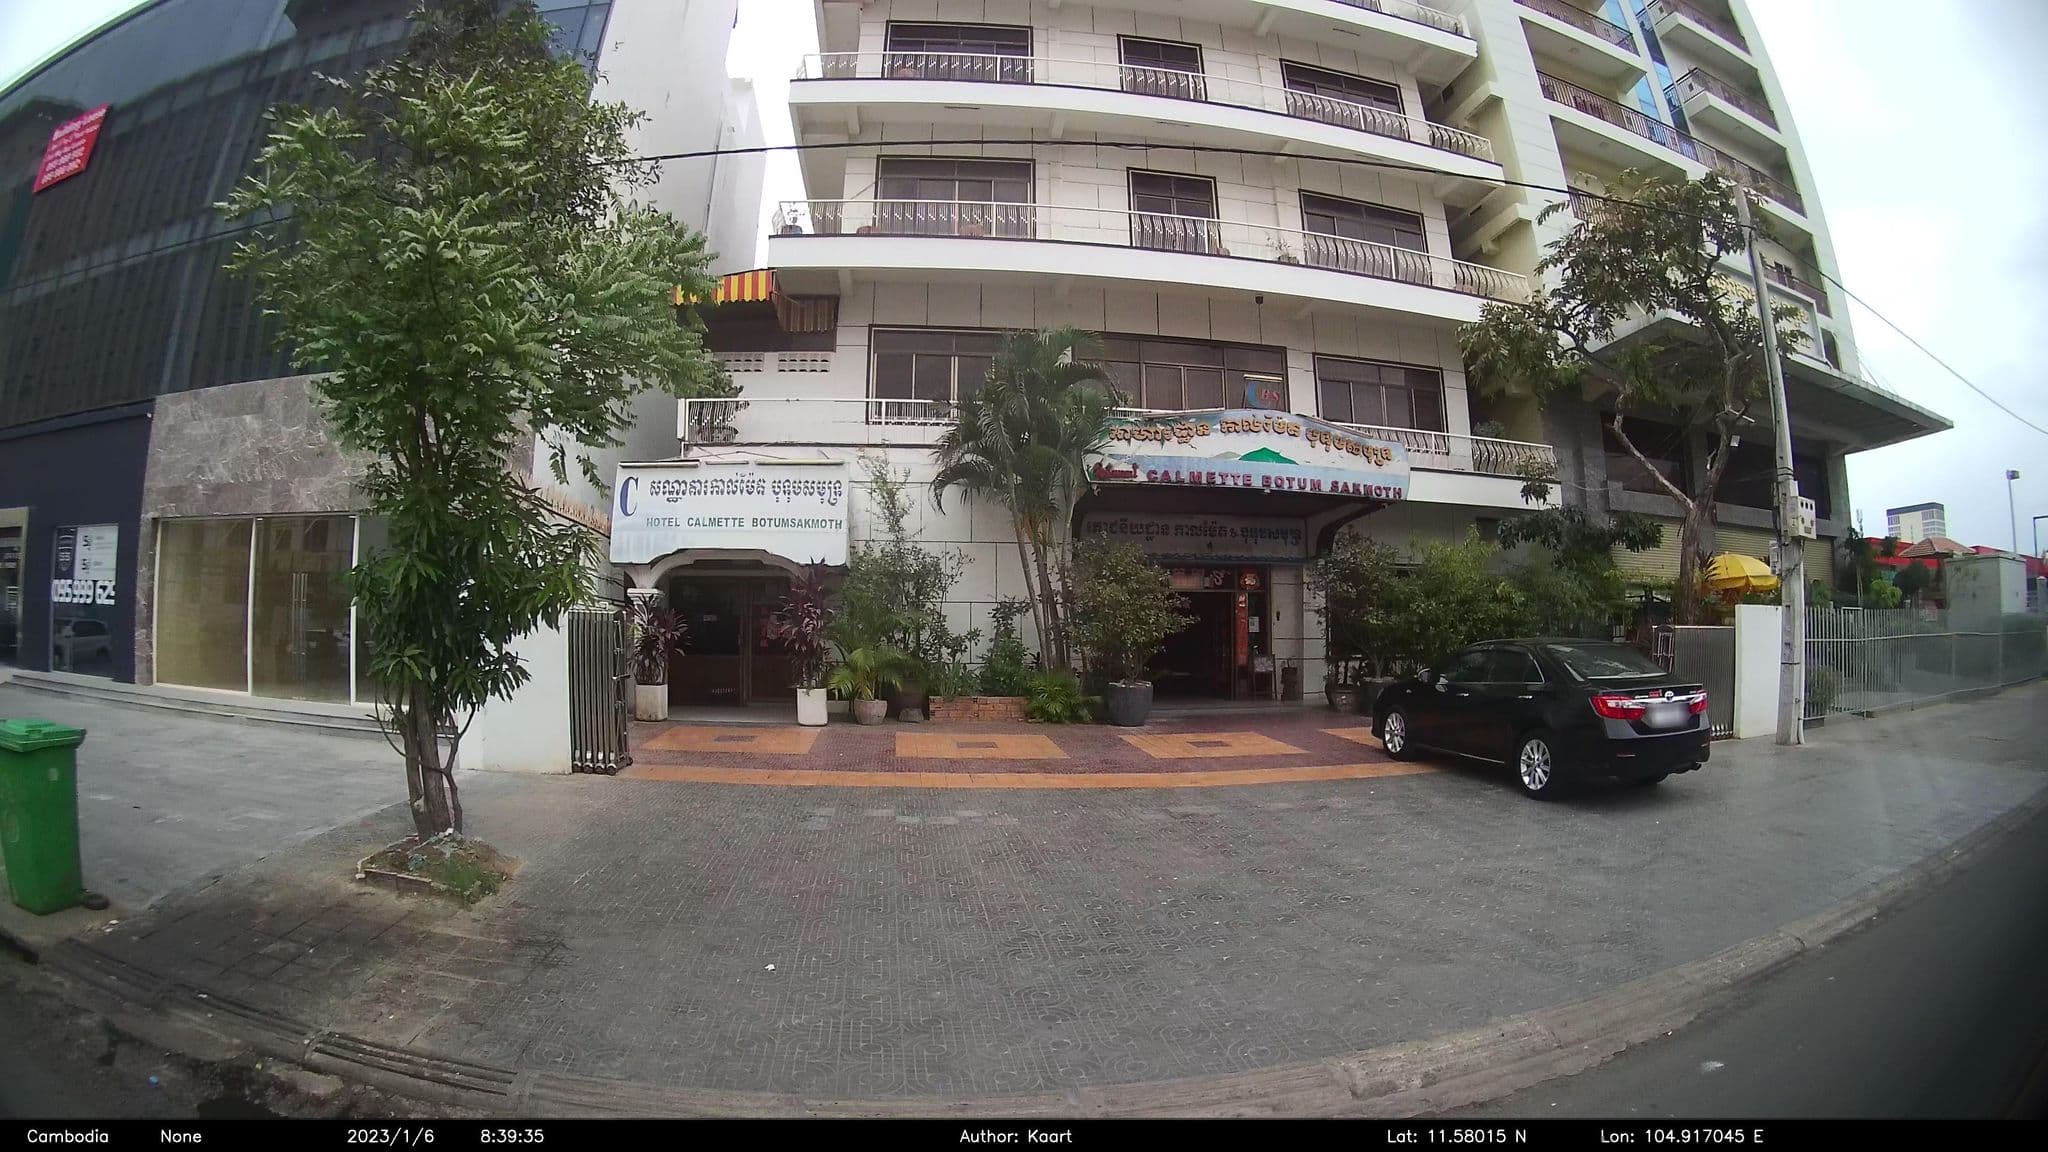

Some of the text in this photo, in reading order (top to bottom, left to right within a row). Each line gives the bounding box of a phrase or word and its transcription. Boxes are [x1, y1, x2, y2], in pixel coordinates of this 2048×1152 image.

[619, 476, 639, 517] C
[1146, 470, 1402, 499] CALMETTE BOTUM SAKMOTH
[646, 517, 843, 530] HOTEL CALMETTE BOTUMSAKMOTH
